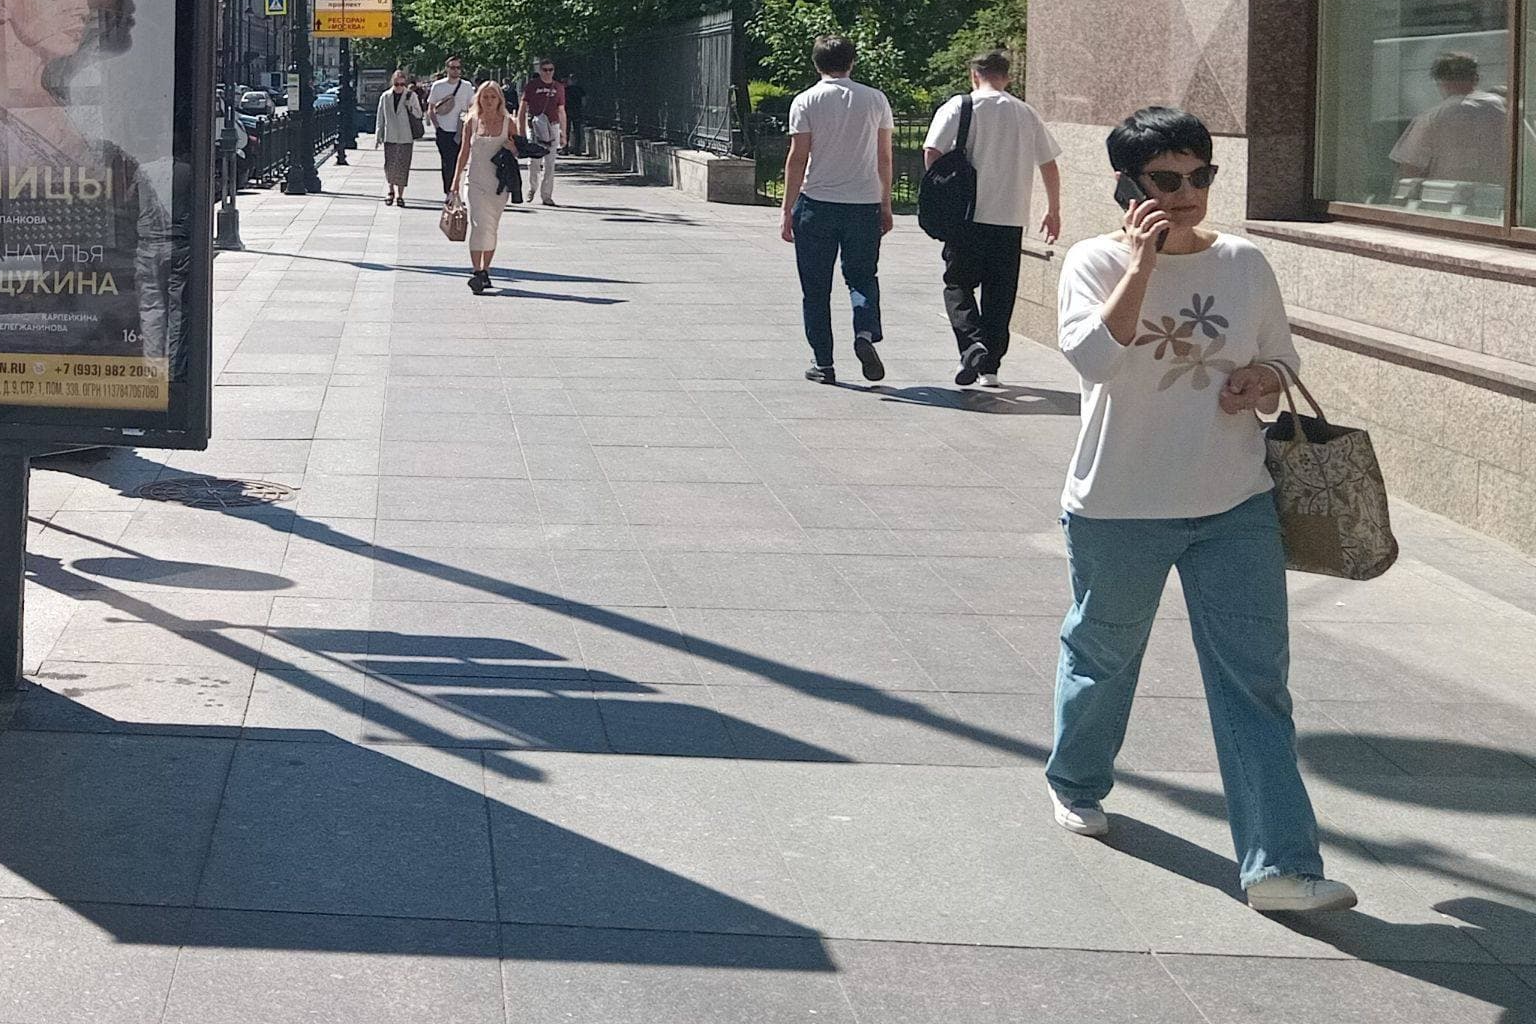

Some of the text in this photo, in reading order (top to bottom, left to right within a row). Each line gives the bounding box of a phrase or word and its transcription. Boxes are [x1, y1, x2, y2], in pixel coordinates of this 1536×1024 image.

[0, 215, 47, 225] ПАНКОВА
[5, 243, 104, 263] НАТАЛЬЯ
[123, 329, 144, 343] 16+
[55, 363, 69, 375] +7
[73, 363, 101, 377] (993)
[105, 365, 126, 377] 982
